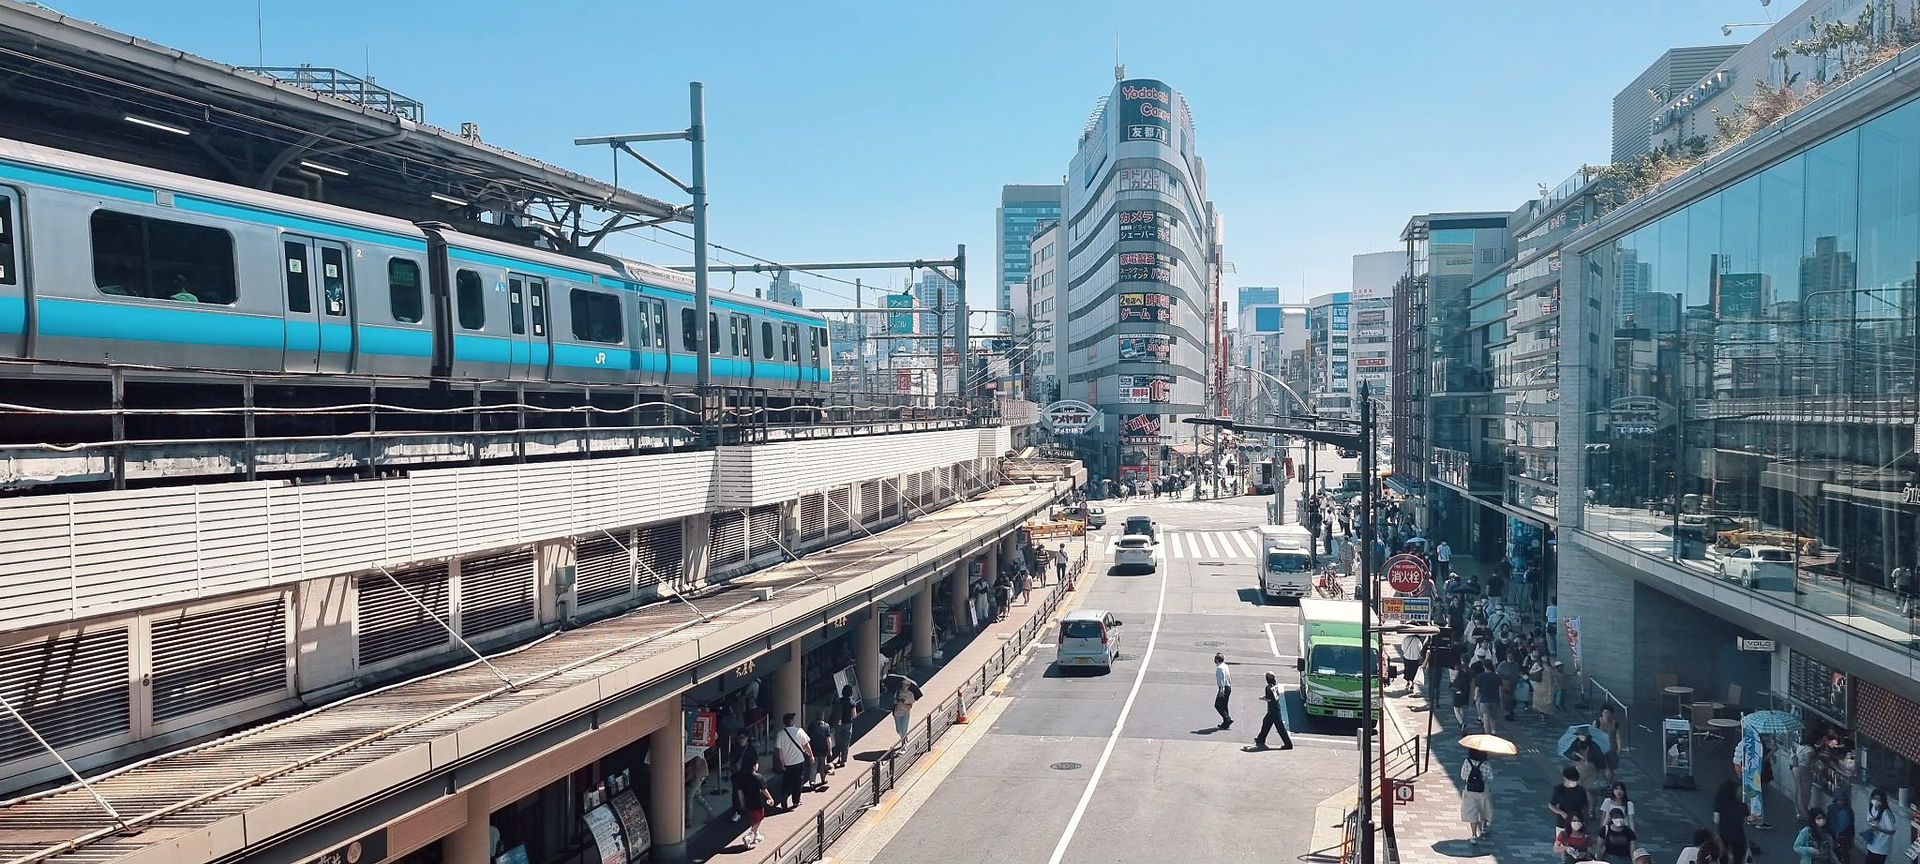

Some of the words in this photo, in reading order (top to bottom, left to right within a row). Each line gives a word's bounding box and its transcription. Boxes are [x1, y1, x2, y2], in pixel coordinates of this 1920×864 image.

[1123, 86, 1168, 104] Yodoba
[1141, 103, 1170, 122] Cam
[1131, 127, 1166, 142] 友都八
[1120, 211, 1154, 224] カメラ
[1121, 231, 1155, 239] シェーバー
[1121, 307, 1151, 320] ゲーム
[595, 352, 606, 364] JR
[1391, 570, 1420, 584] 消火栓
